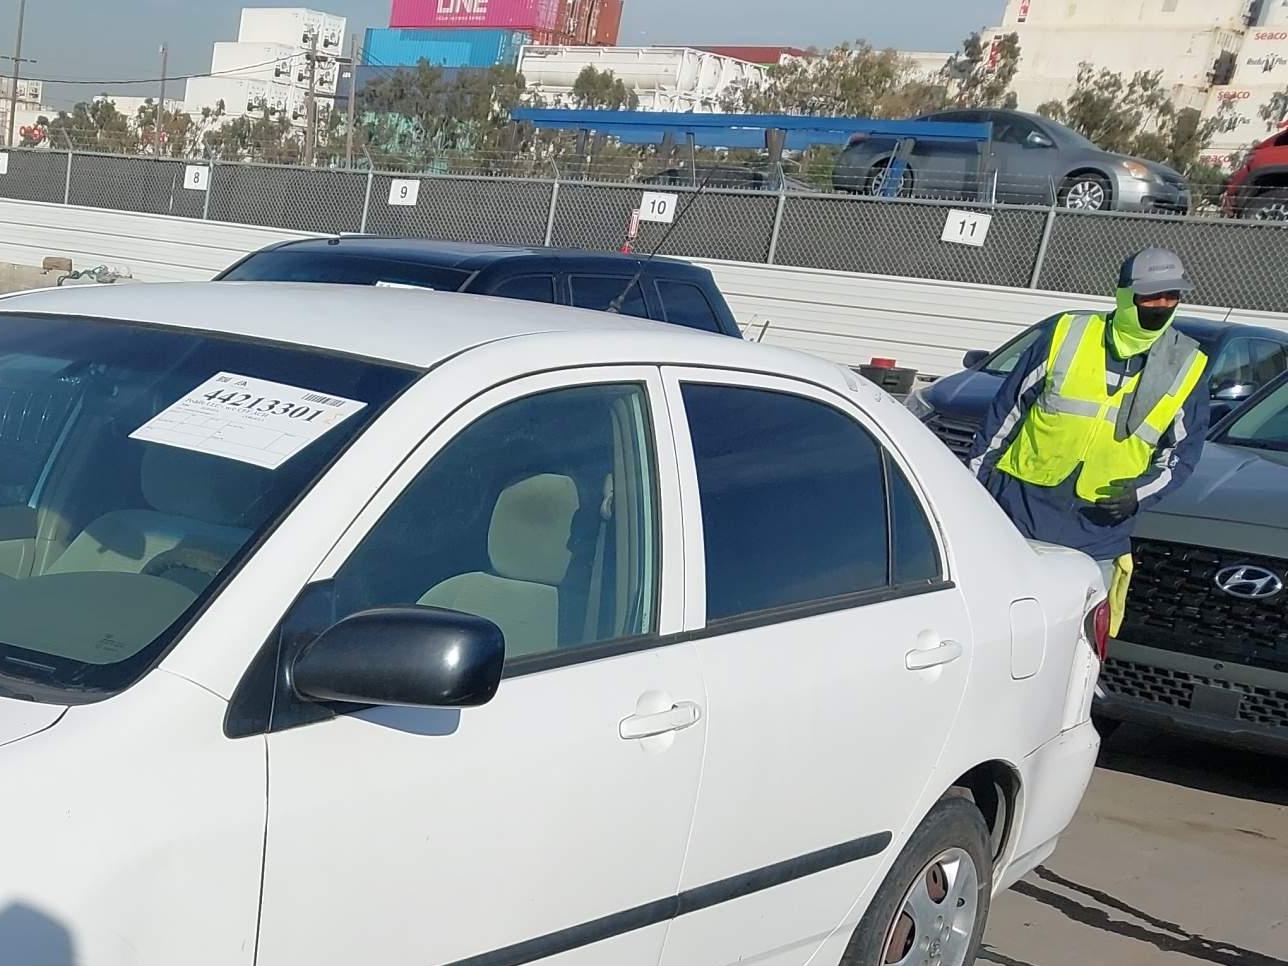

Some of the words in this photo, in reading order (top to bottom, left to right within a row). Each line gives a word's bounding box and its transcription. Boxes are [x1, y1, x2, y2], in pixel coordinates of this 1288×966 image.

[1255, 32, 1288, 40] seaco
[193, 171, 200, 184] 8
[400, 185, 408, 199] 9
[650, 199, 667, 215] 10
[959, 219, 977, 237] 11
[203, 389, 324, 422] 44213301
